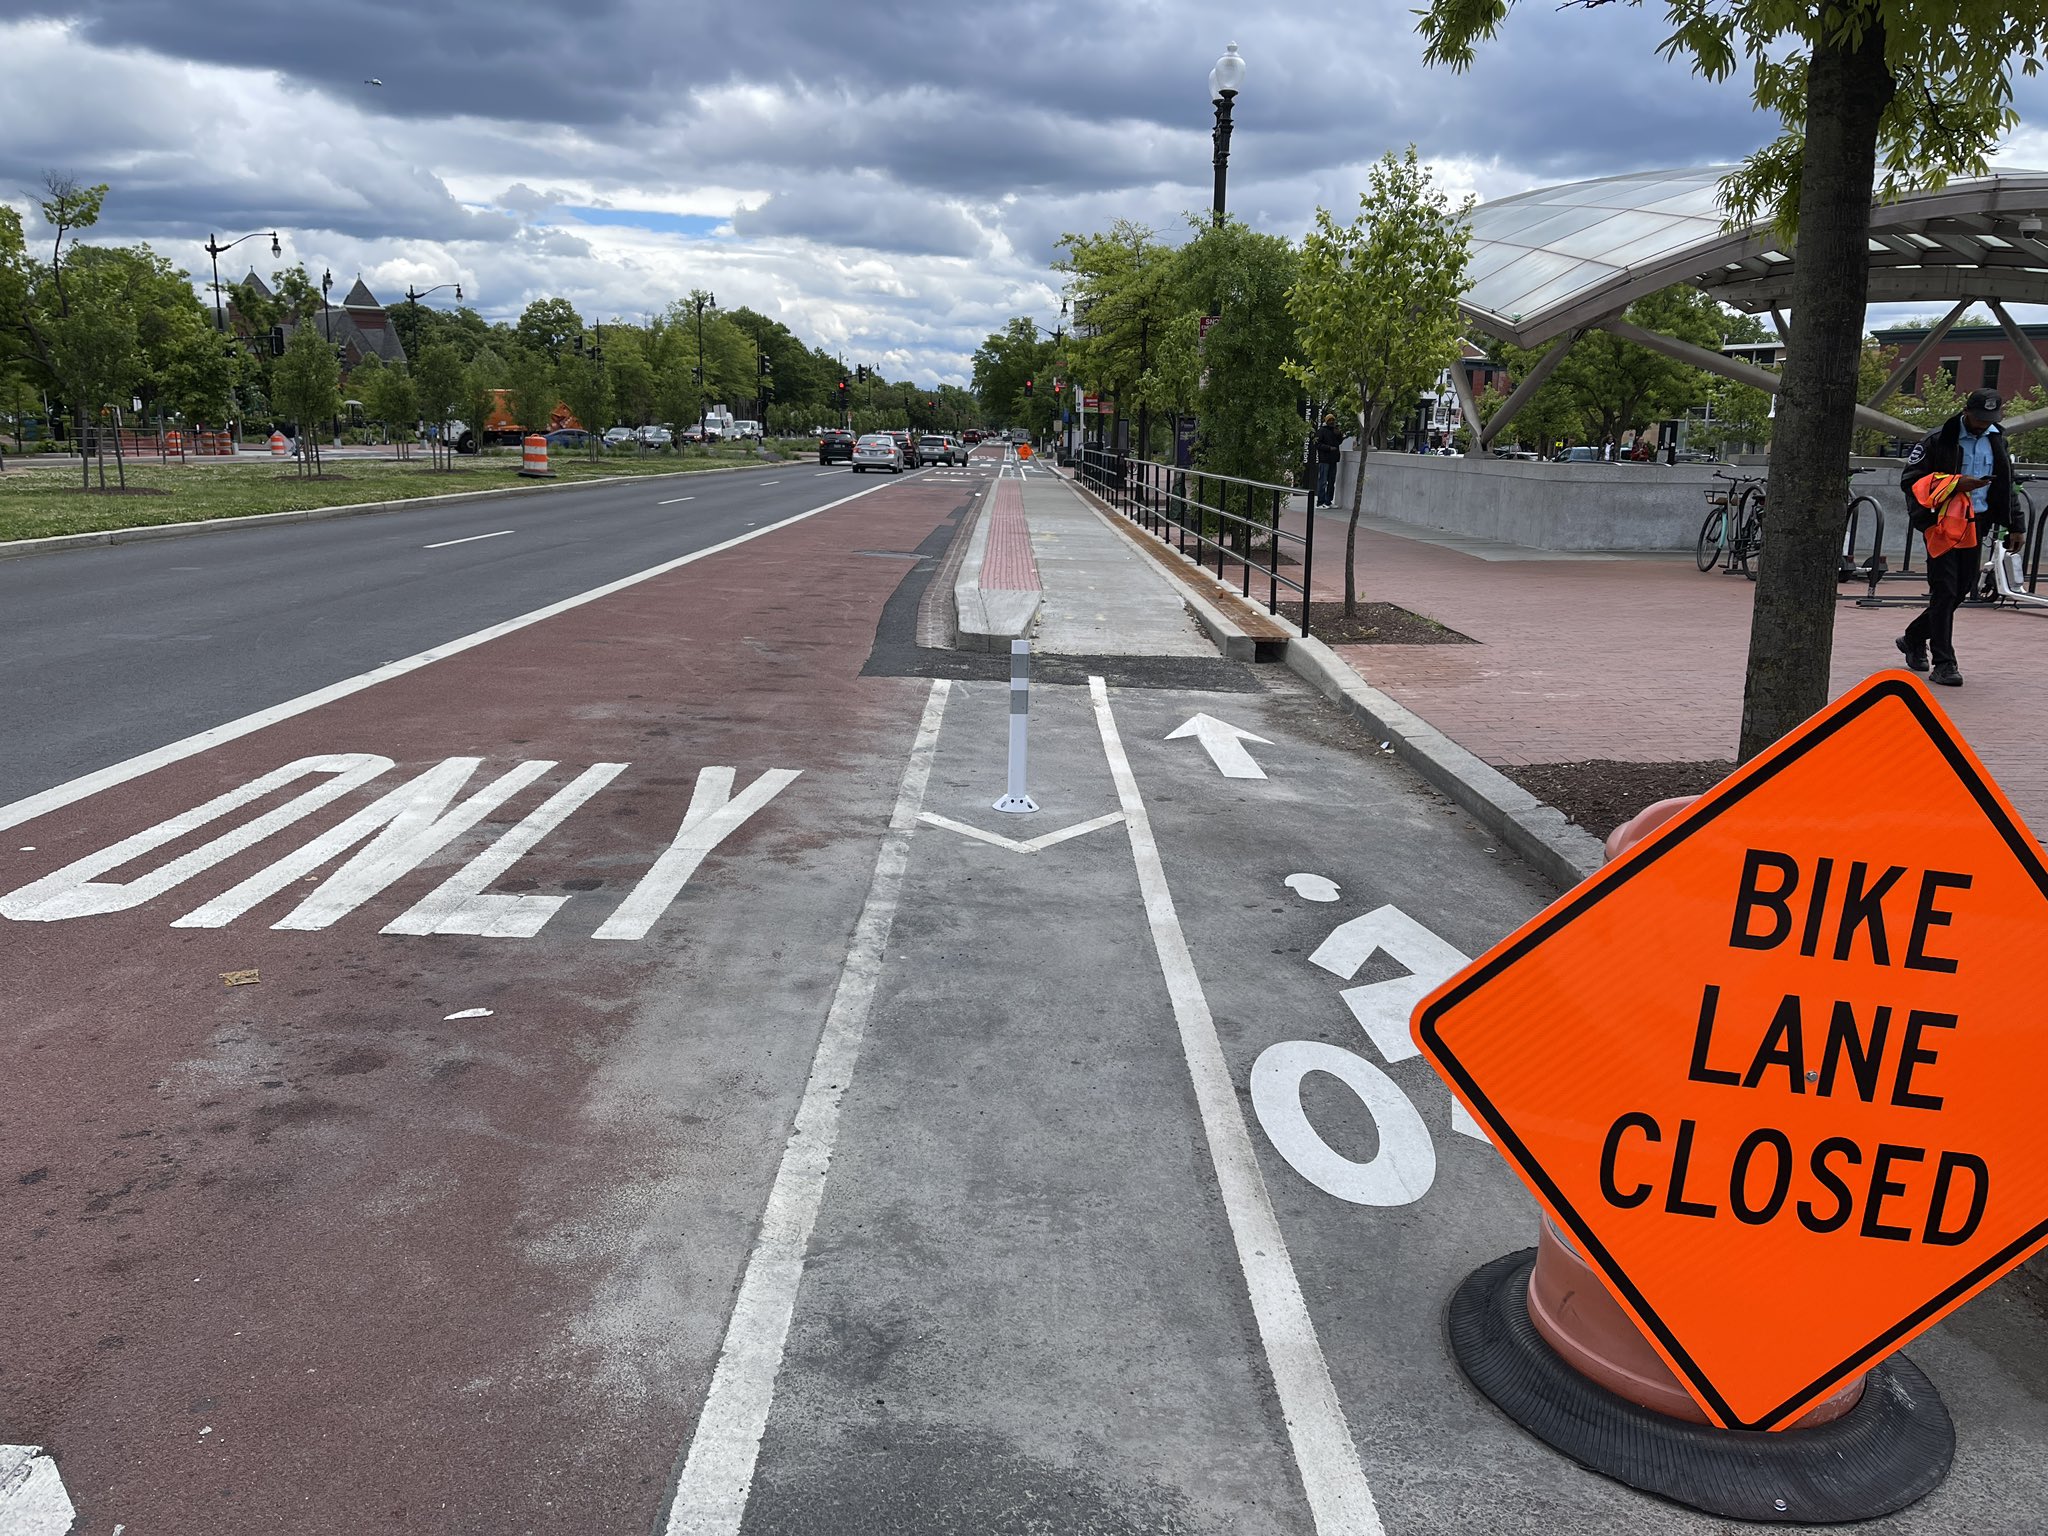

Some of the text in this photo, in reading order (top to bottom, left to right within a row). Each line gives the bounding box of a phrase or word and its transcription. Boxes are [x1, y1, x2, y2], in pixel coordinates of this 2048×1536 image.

[0, 753, 804, 940] ONLY
[1728, 849, 1974, 974] BIKE
[1687, 984, 1959, 1111] LANE
[1599, 1111, 1990, 1247] CLOSED
